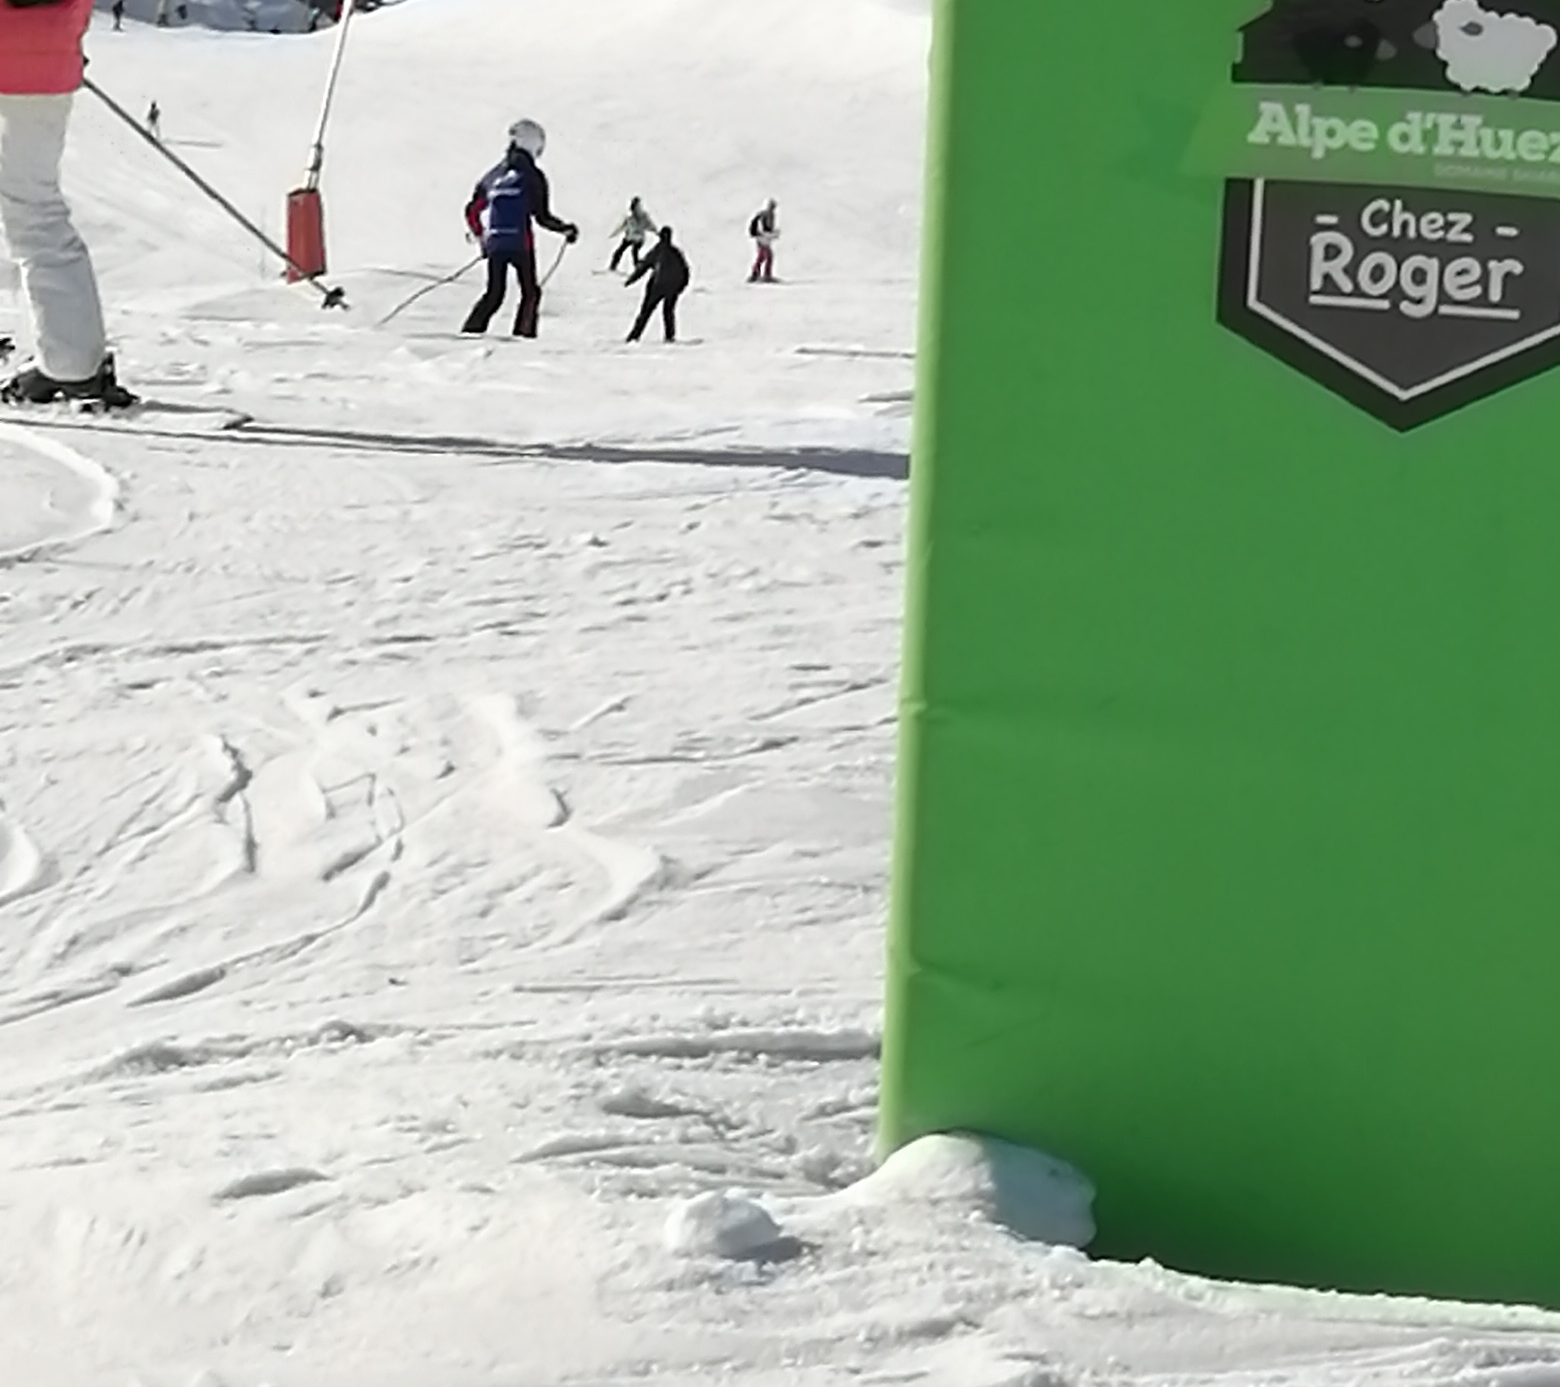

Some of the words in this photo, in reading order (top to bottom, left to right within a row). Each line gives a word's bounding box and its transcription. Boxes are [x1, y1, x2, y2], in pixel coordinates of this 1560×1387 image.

[1247, 102, 1378, 160] Alpe
[1360, 199, 1475, 243] Chez
[1309, 230, 1524, 317] Roger
